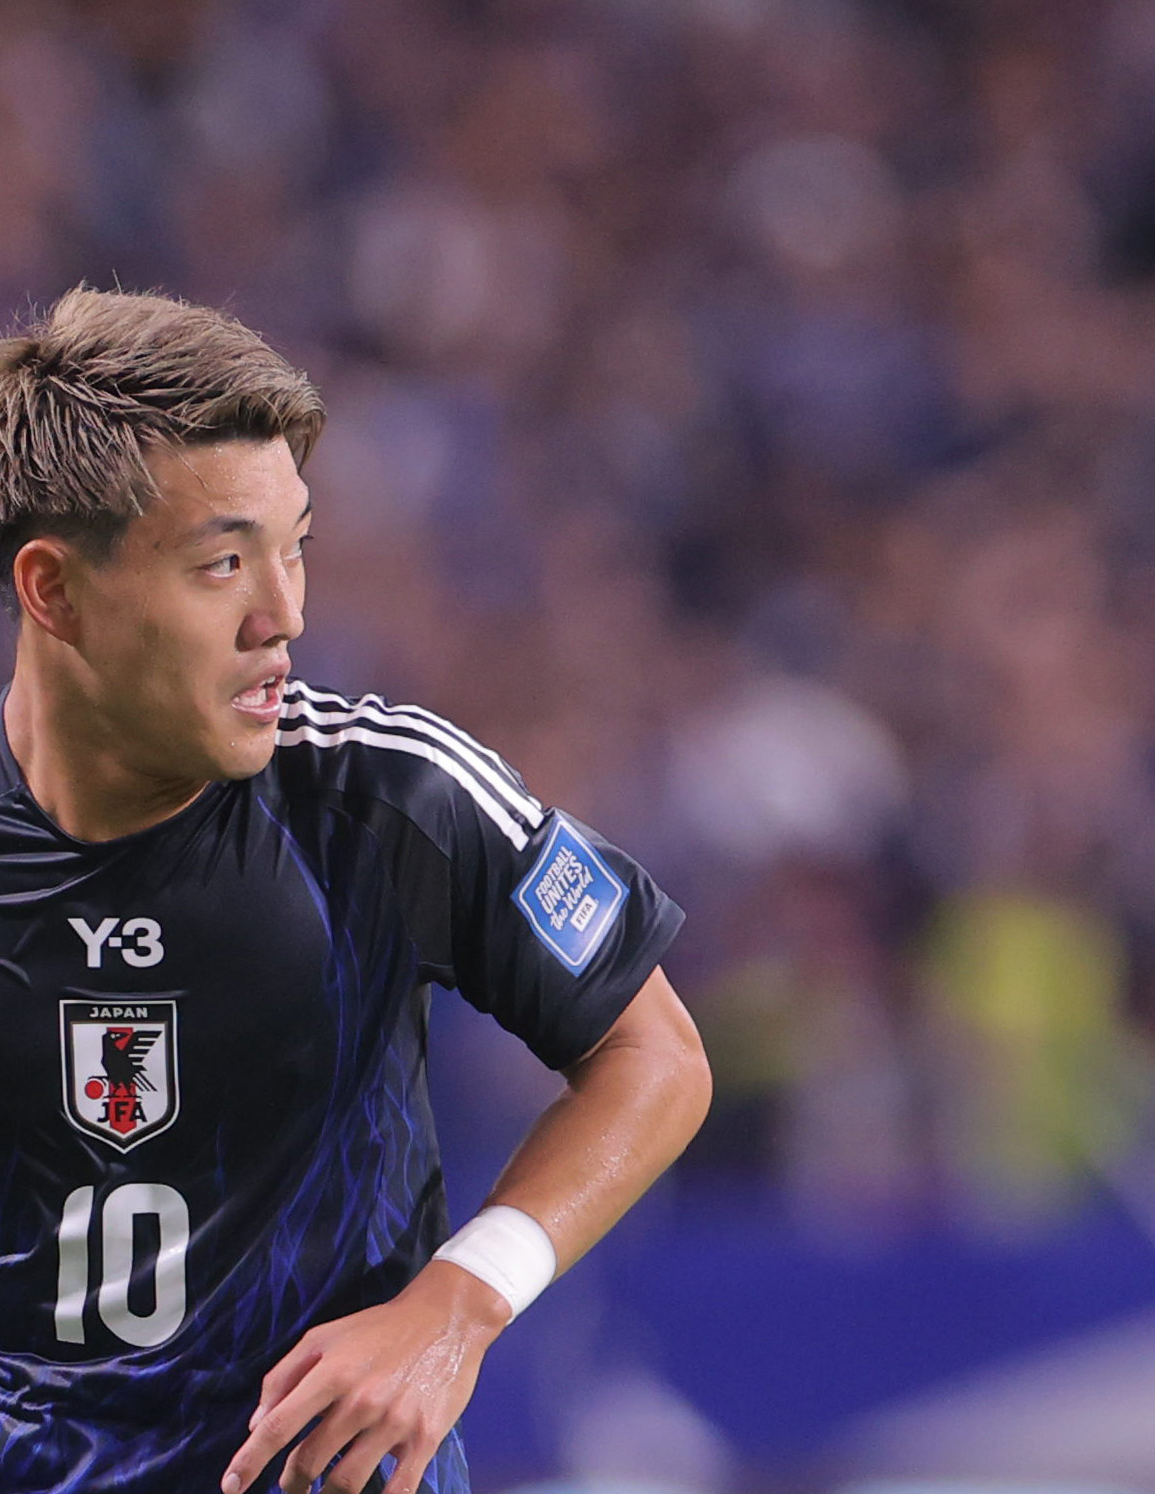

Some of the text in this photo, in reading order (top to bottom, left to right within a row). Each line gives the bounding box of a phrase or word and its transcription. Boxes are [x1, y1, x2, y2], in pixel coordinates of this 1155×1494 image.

[535, 846, 573, 900] FOOTBALL
[541, 856, 582, 914] UNITES
[550, 908, 568, 931] the
[576, 903, 593, 925] FIFA
[67, 917, 165, 969] Y-3
[89, 1007, 149, 1019] JAPAN
[97, 1101, 148, 1123] JFA
[54, 1183, 190, 1347] 10
